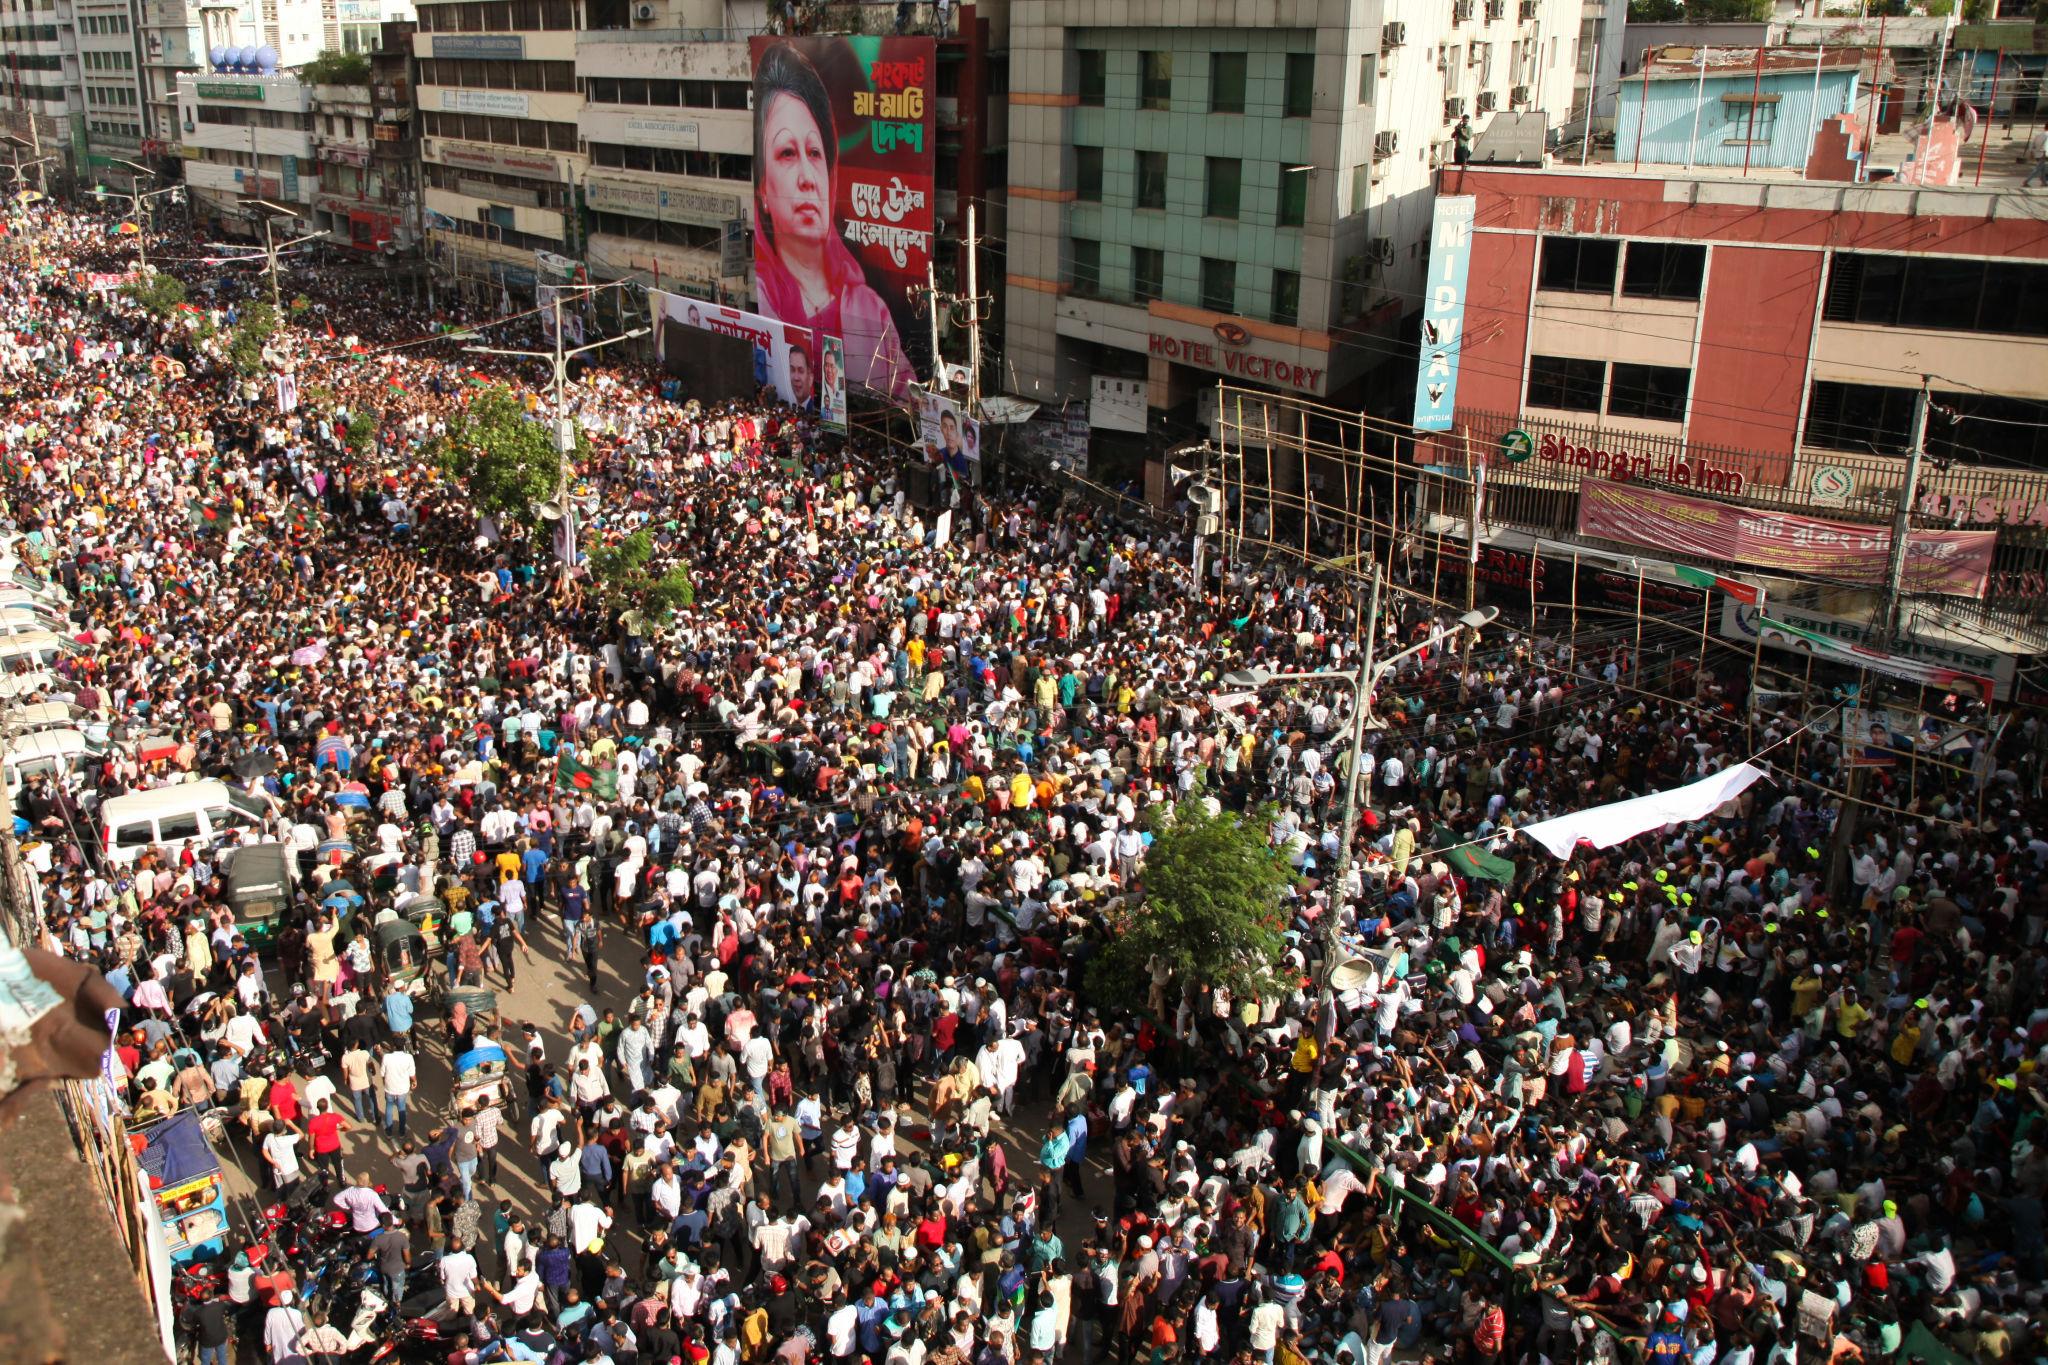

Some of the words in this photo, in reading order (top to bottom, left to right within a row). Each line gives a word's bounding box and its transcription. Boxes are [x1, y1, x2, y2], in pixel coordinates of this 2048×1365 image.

[871, 55, 926, 89] সংকটে
[853, 86, 924, 119] মা-মাটি
[675, 124, 697, 134] LIMITED
[871, 120, 924, 154] দেশ
[1437, 203, 1472, 216] HOTEL
[844, 218, 934, 269] বাংলাদেশ
[1424, 221, 1466, 409] MIDWAY
[1149, 333, 1217, 367] HOTEL
[1224, 350, 1323, 390] VICTORY
[1540, 432, 1692, 483] Shangri-la
[1696, 458, 1745, 495] Inn
